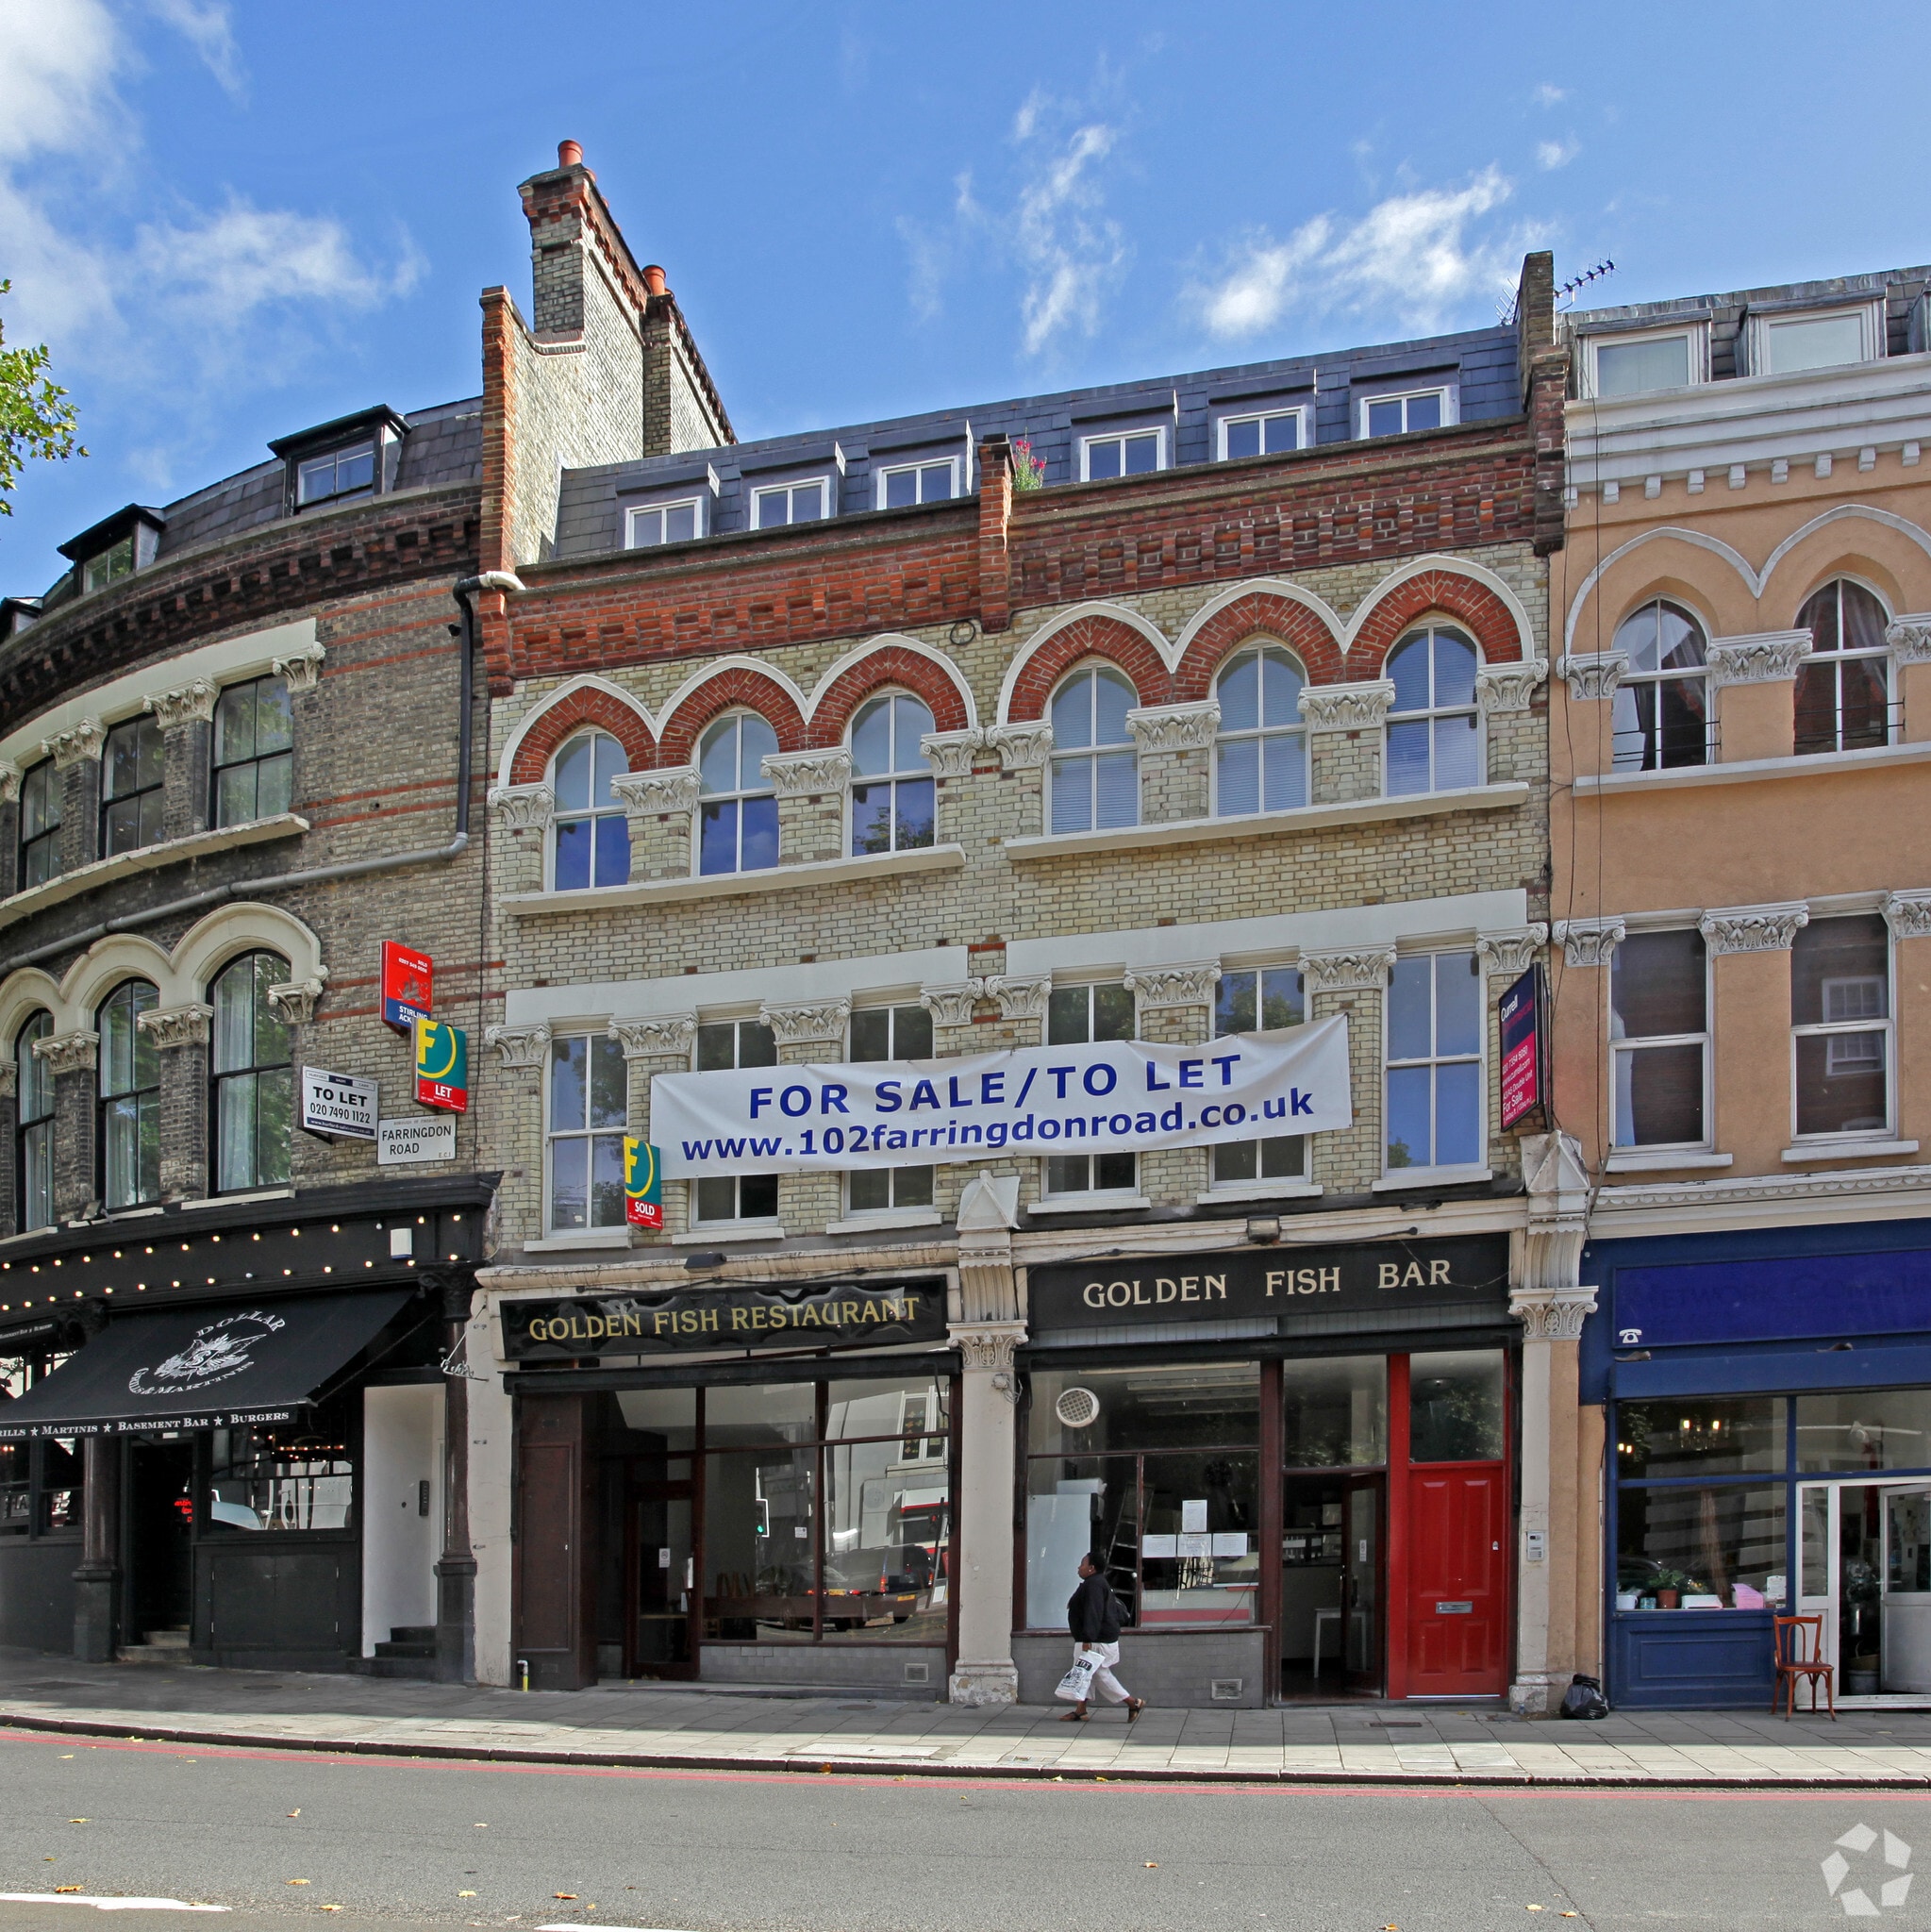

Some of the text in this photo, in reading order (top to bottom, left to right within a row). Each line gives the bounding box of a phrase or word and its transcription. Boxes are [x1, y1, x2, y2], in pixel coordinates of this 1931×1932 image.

[399, 1006, 428, 1021] STIRLING
[313, 1086, 368, 1108] TO LET
[435, 1084, 453, 1099] LET
[749, 1085, 850, 1120] FOR
[1146, 1054, 1241, 1092] LET
[1511, 1091, 1523, 1108] Sale
[309, 1102, 371, 1124] 020 7490 1122
[681, 1087, 1314, 1161] www.102farringdonroad.co.uk
[382, 1125, 452, 1141] FARRINGDON
[390, 1142, 420, 1156] ROAD
[635, 1201, 656, 1216] SOLD
[1083, 1259, 1452, 1308] GOLDEN FISH BAR
[194, 1310, 286, 1338] DOLLAR
[529, 1297, 921, 1341] GOLDEN FISH RESTAURANT
[42, 1424, 98, 1435] MARTINIS
[118, 1419, 181, 1431] BASEMENT
[183, 1417, 209, 1428] BAR
[230, 1411, 290, 1424] BURGERS
